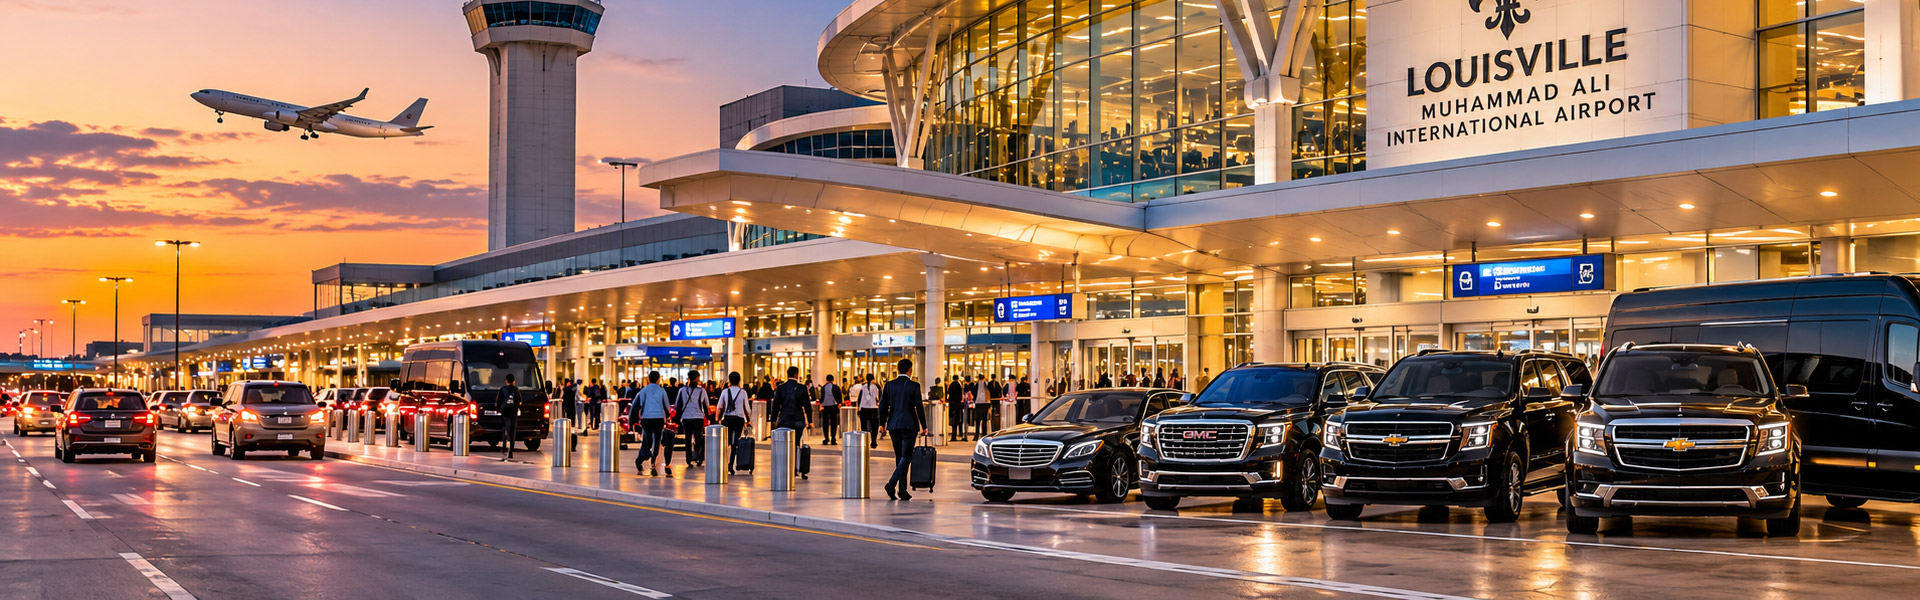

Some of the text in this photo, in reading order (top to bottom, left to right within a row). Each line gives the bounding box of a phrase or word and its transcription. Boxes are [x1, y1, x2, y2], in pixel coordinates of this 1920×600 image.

[1407, 27, 1628, 97] LOUISVILLE
[1387, 92, 1656, 147] INTERNATIONAL AIRPORT
[1421, 74, 1610, 120] MUHAMMAD ALI
[1182, 430, 1218, 440] GMC
